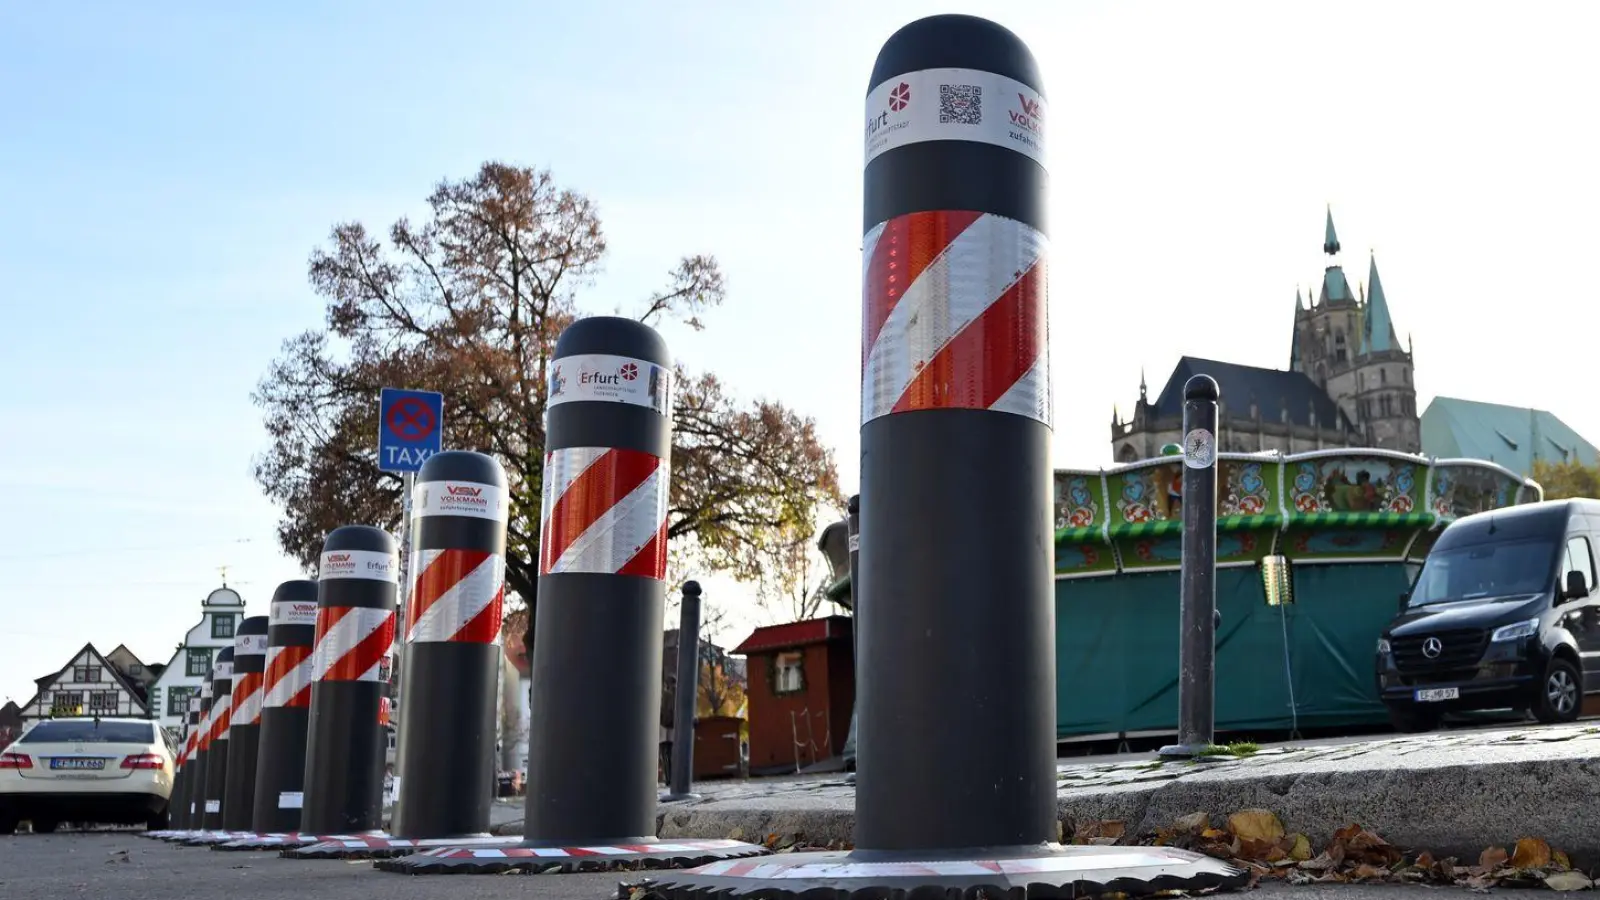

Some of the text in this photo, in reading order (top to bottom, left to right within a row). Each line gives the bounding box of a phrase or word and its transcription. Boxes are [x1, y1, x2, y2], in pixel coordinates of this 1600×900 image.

[581, 372, 619, 384] Erfurt
[447, 486, 482, 497] VSV
[440, 496, 488, 506] VOLKMANN
[367, 561, 389, 572] Erfurt
